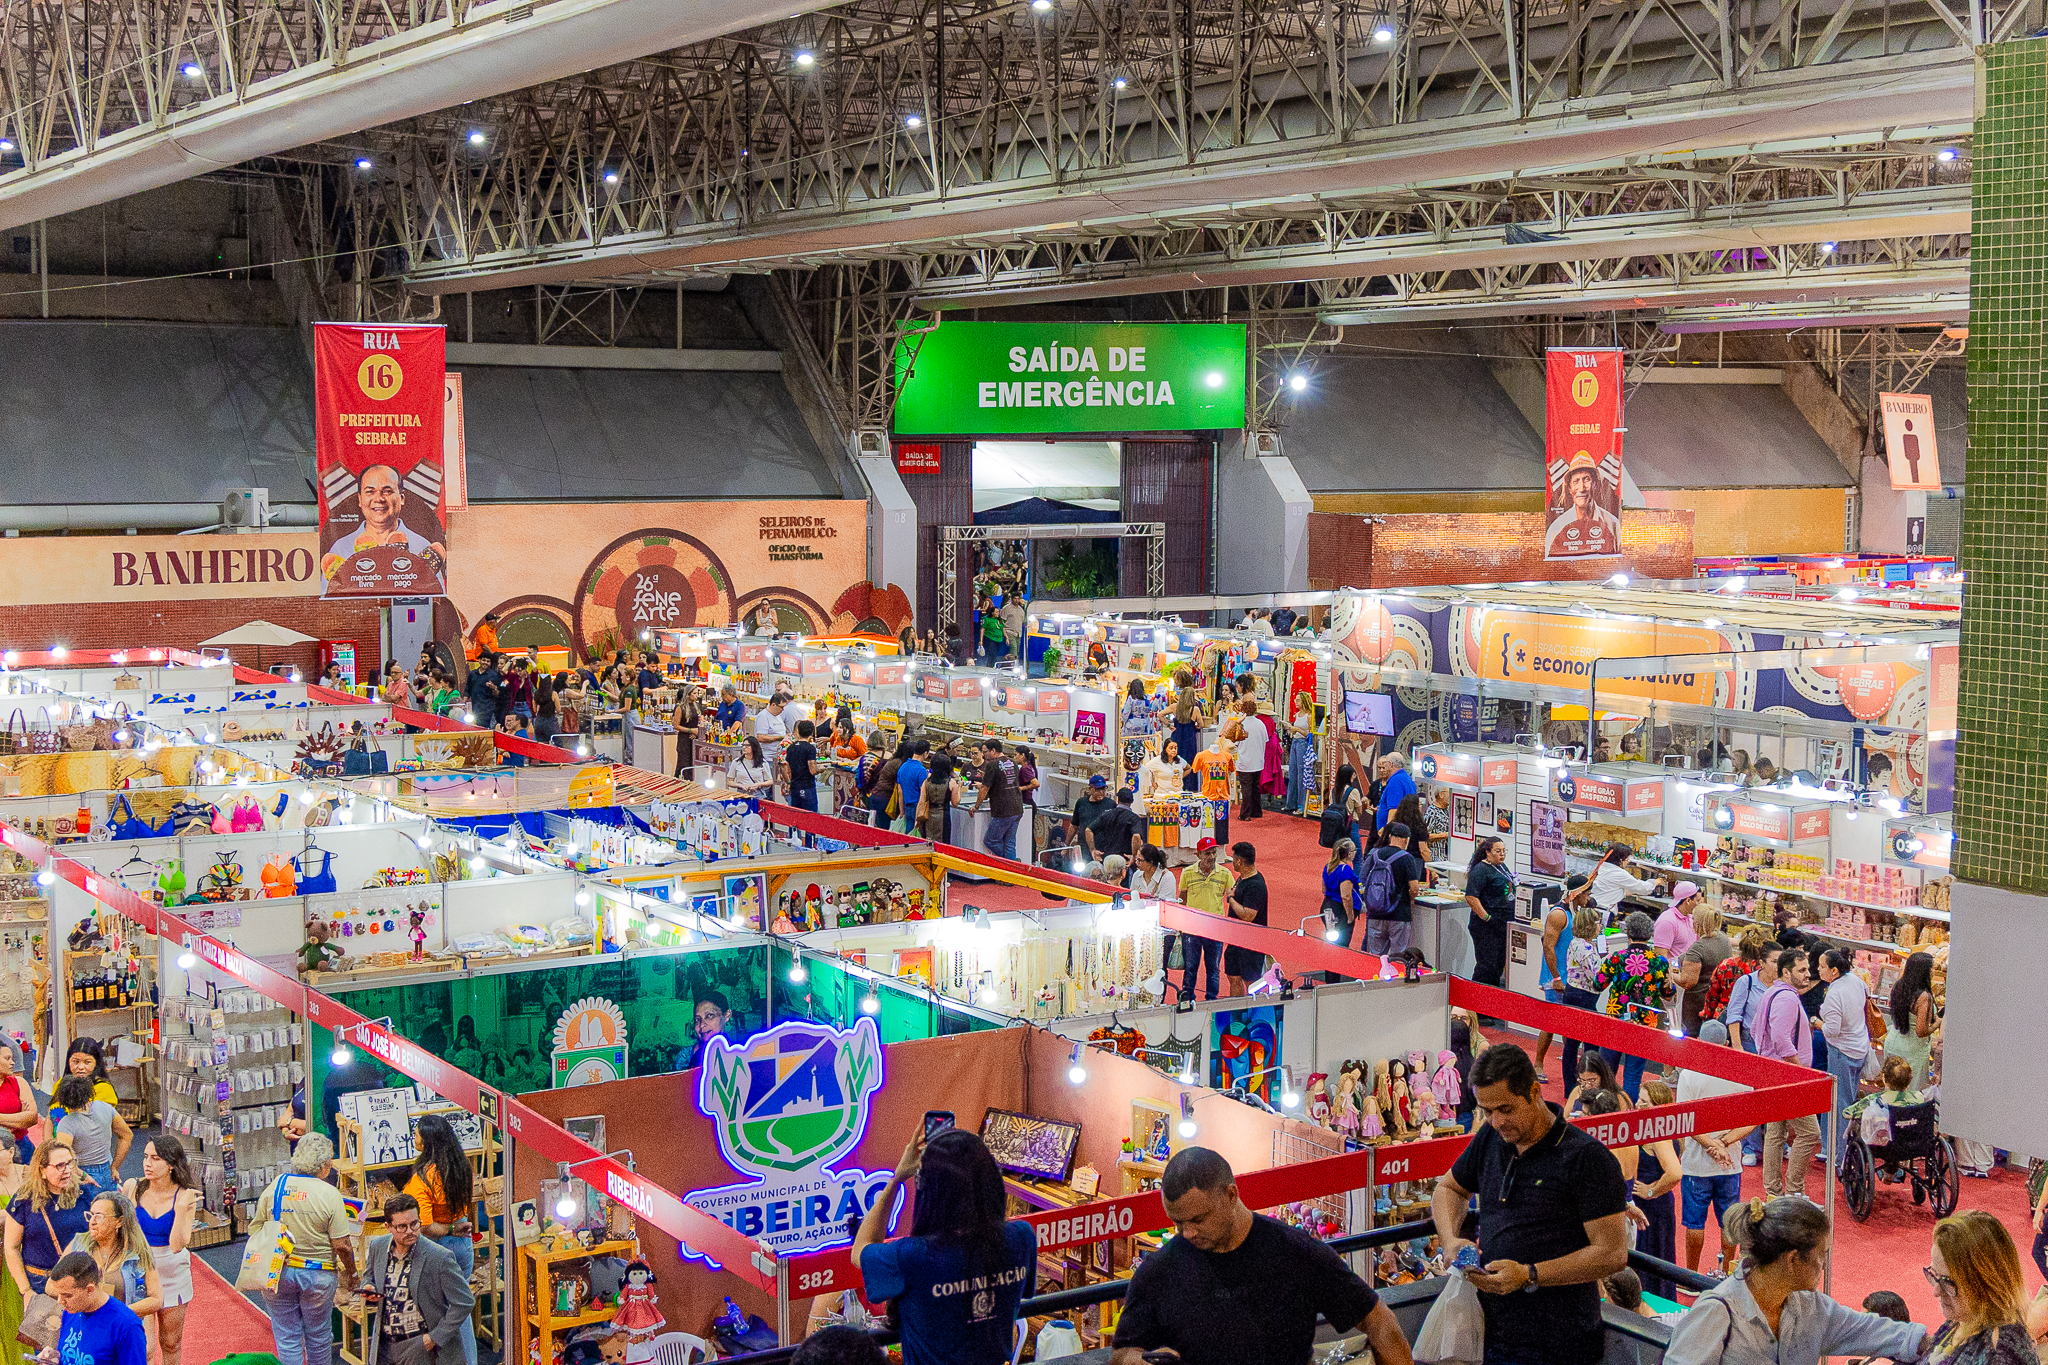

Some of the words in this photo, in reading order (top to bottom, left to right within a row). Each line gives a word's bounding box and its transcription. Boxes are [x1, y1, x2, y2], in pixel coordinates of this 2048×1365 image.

[363, 332, 400, 350] RUA
[1009, 341, 1098, 373] SAÍDA
[1109, 346, 1146, 372] DE
[1574, 354, 1598, 368] RUA
[367, 364, 394, 389] 16
[978, 376, 1175, 408] EMERGÊNCIA
[1578, 378, 1593, 398] 17
[1886, 401, 1928, 415] BANHEIRO
[339, 413, 422, 427] PREFEITURA
[1569, 423, 1601, 435] SEBRAE
[355, 432, 407, 446] SEBRAE
[905, 451, 924, 460] SAÍDA
[900, 459, 939, 467] EMERGÊNCIA
[1292, 505, 1303, 516] 09
[759, 516, 813, 527] SELEIROS
[814, 517, 826, 526] DE
[894, 512, 907, 524] 08
[759, 527, 838, 539] PERNAMBUCO:
[797, 545, 811, 553] QUE
[768, 552, 824, 561] TRANSFORMA
[113, 548, 314, 586] BANHEIRO
[351, 574, 382, 582] mercado
[387, 573, 418, 581] mercado
[359, 580, 374, 588] livre
[394, 580, 412, 588] pago
[1889, 602, 1910, 610] EGITO
[1569, 643, 1603, 658] SEBRAE
[842, 667, 850, 677] 09
[1533, 656, 1591, 676] econo
[916, 680, 924, 688] 08
[1623, 672, 1696, 687] ativa
[1848, 677, 1886, 689] SEBRAE
[997, 693, 1006, 702] 07
[1422, 760, 1435, 773] 06
[1560, 781, 1574, 795] 05
[1581, 784, 1597, 794] CAFÉ
[1597, 786, 1615, 797] GRÃO
[1580, 792, 1592, 800] DAS
[1593, 793, 1616, 805] PEDRAS
[1739, 812, 1755, 822] VERA
[1755, 814, 1781, 826] PEIXOTO
[1801, 820, 1822, 829] SEBRAE
[1739, 820, 1755, 829] BOLO
[1755, 822, 1763, 830] DE
[1764, 824, 1781, 833] ROLO
[1553, 830, 1562, 841] SEM
[1533, 838, 1545, 849] LEITE
[1545, 840, 1551, 849] DO
[202, 939, 217, 961] CRUZ
[217, 946, 226, 967] DA
[226, 951, 244, 977] BAIXA
[243, 961, 263, 988] VERDE
[308, 1001, 320, 1016] 383
[355, 1021, 370, 1047] SÃO
[370, 1031, 389, 1058] JOSÉ
[389, 1041, 401, 1064] DO
[401, 1048, 441, 1087] BELMONTE
[508, 1113, 522, 1132] 382
[1633, 1111, 1695, 1140] JARDIM
[1381, 1159, 1410, 1176] 401
[607, 1169, 654, 1218] RIBEIRÃO
[692, 1194, 747, 1209] GOVERNO
[750, 1183, 811, 1201] MUNICIPAL
[813, 1180, 827, 1190] DE
[804, 1226, 834, 1241] AÇÃO
[835, 1223, 849, 1234] NO
[1036, 1206, 1134, 1248] RIBEIRÃO
[799, 1268, 834, 1291] 382
